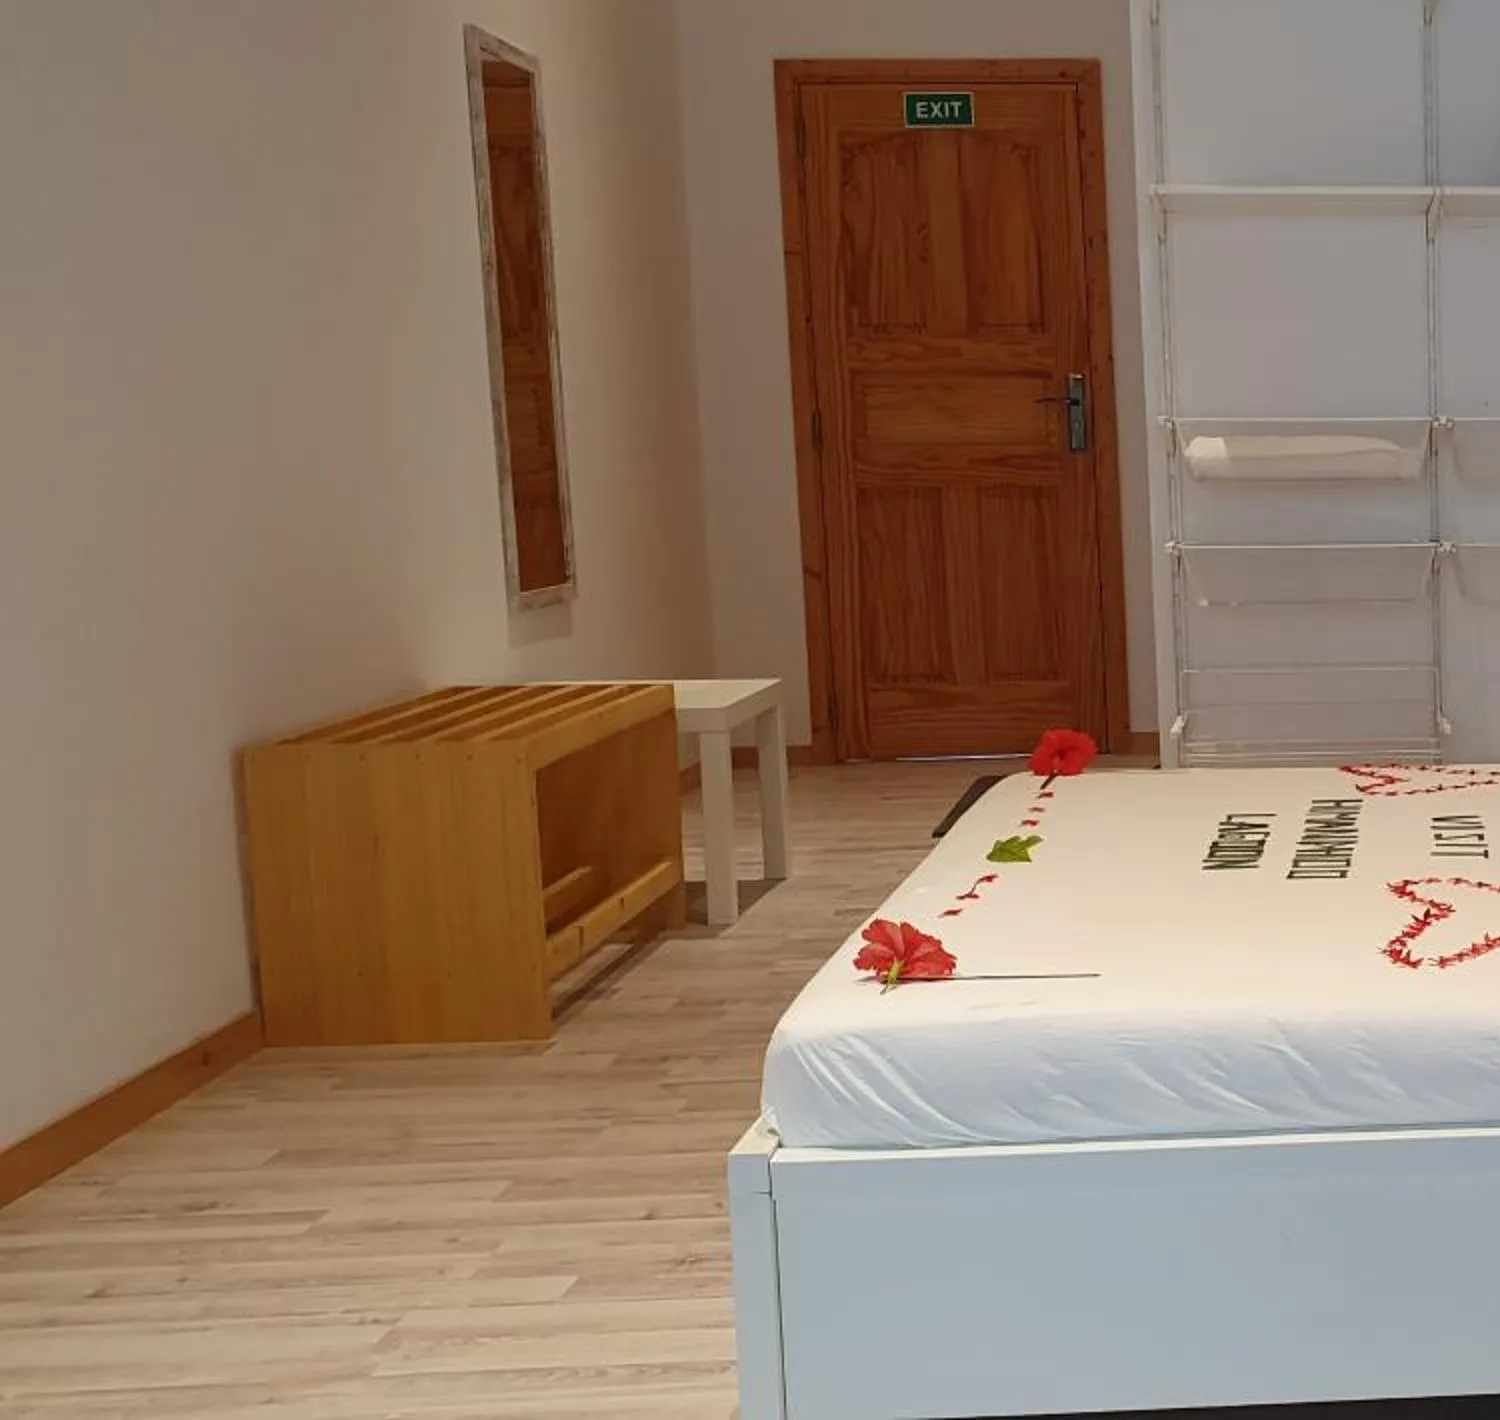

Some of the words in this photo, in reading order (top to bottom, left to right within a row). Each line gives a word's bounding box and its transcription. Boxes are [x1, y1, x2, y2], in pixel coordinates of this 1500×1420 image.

[916, 102, 962, 118] EXIT
[1202, 813, 1277, 870] LAGOON
[1430, 815, 1489, 858] VISIT
